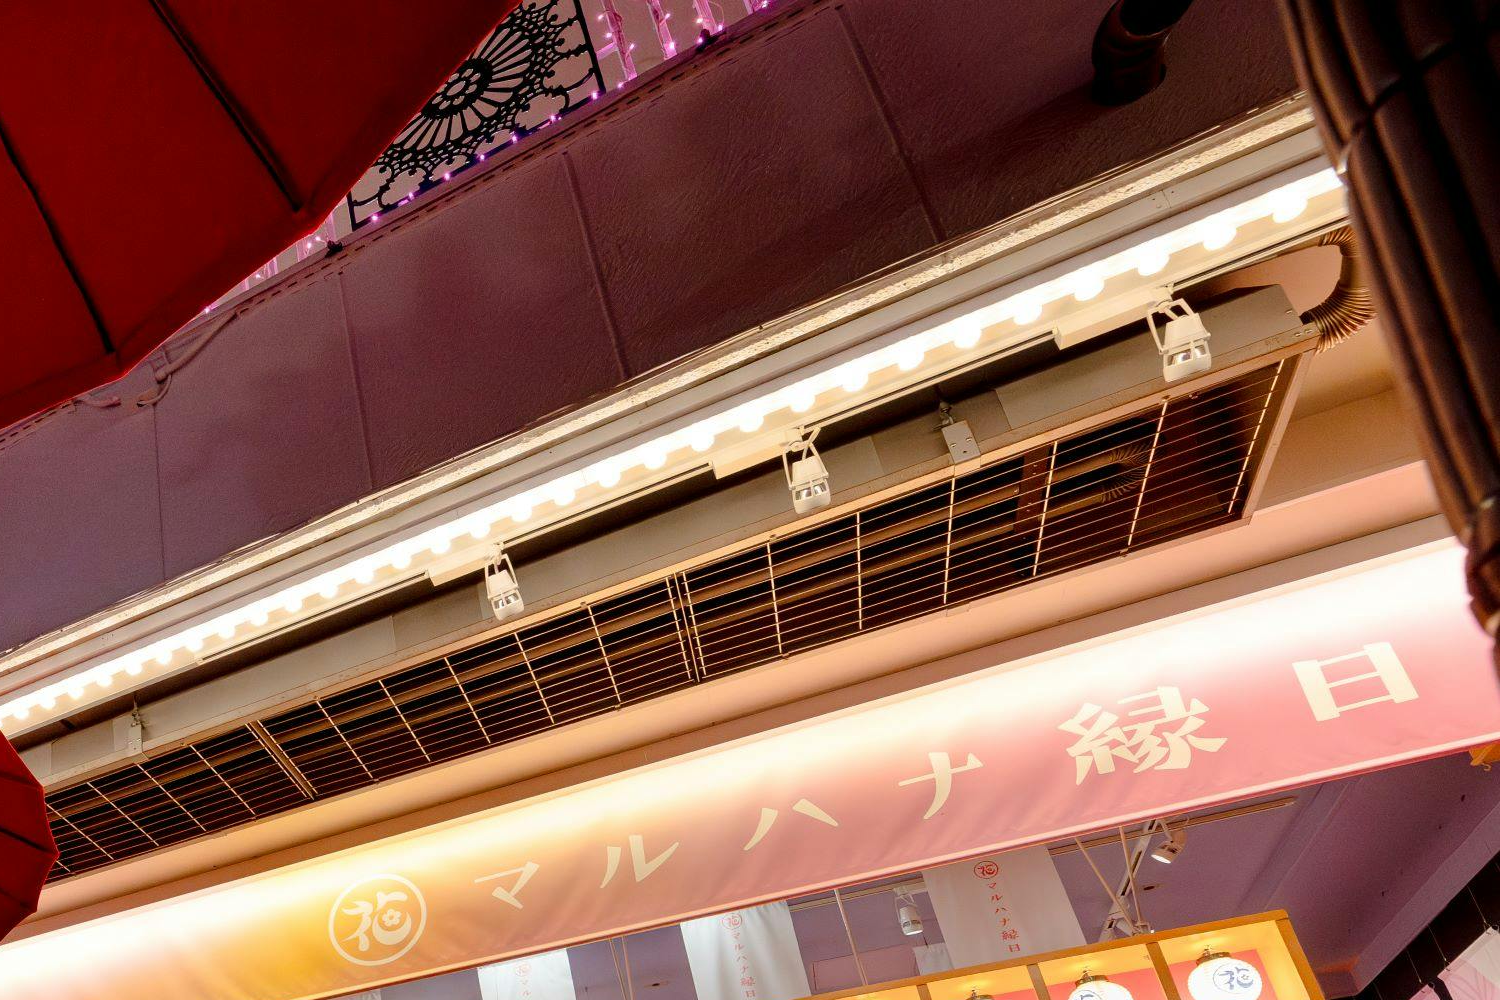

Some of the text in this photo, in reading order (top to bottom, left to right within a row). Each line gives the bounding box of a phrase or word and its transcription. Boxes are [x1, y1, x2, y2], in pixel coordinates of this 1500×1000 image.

[342, 641, 1420, 951] 花 マルハナ縁日
[987, 882, 1021, 953] マルハナ縁日
[733, 930, 756, 998] マルハナ縁日
[1219, 966, 1254, 988] 花
